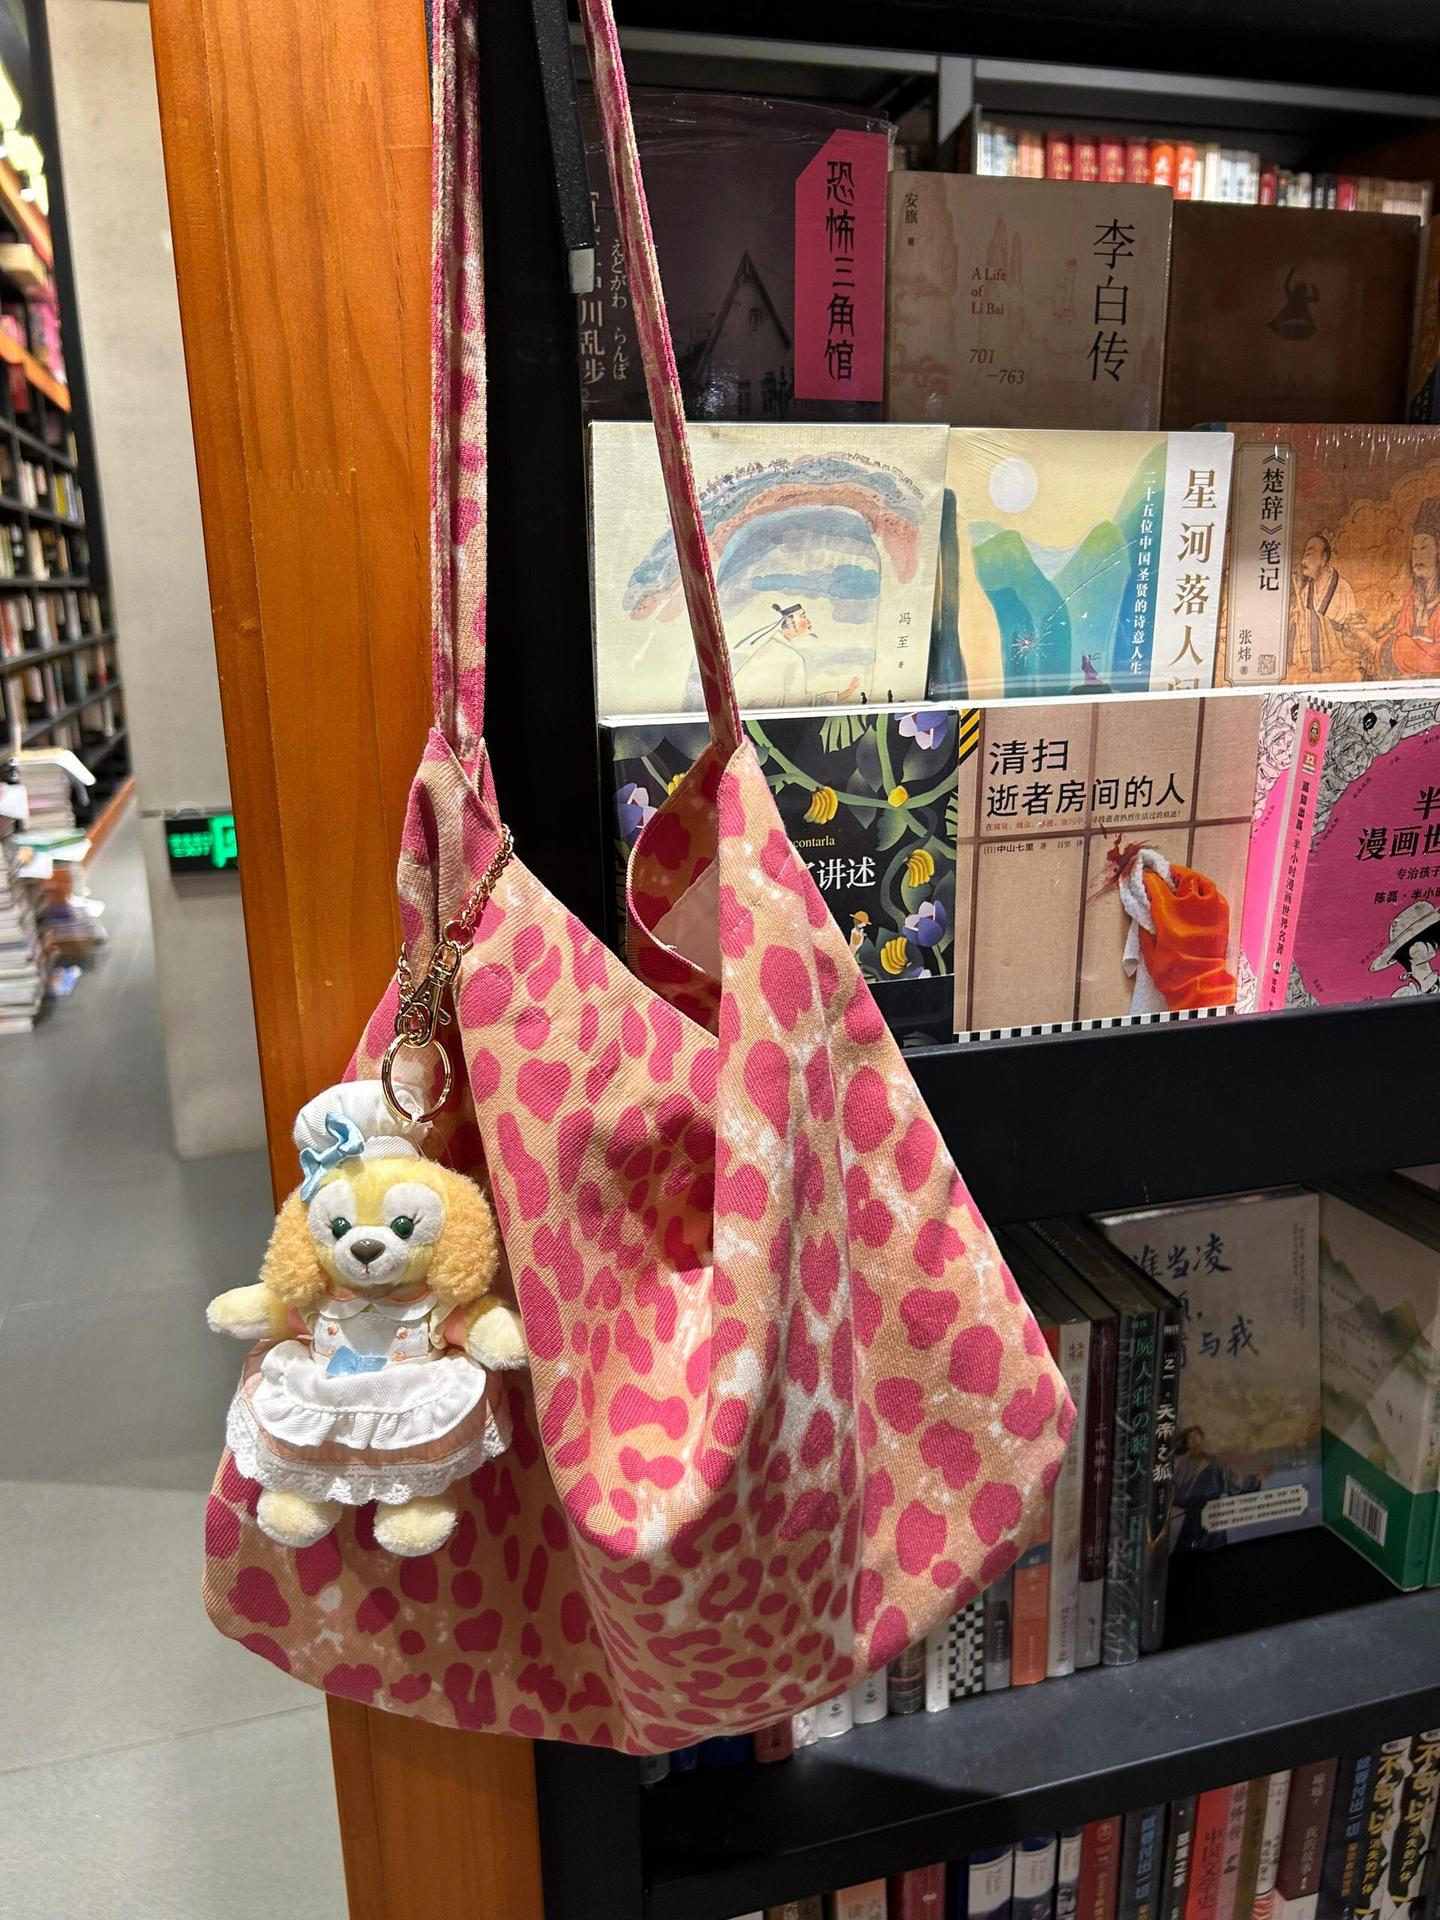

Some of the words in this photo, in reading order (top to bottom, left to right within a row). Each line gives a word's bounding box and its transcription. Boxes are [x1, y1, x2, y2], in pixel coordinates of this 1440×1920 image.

[609, 238, 628, 309] えどがわ
[824, 160, 856, 382] 恐怖三角馆
[971, 267, 982, 281] A
[985, 267, 1006, 282] Life
[971, 284, 984, 297] of
[971, 302, 983, 315] Li
[986, 302, 1005, 315] Bai
[1086, 218, 1136, 382] 李白传
[968, 349, 995, 364] 701
[1257, 454, 1286, 592] 《楚辞》笔记
[896, 611, 912, 649] 冯至
[1237, 628, 1252, 662] 张炜
[988, 738, 1070, 777] 清扫
[985, 772, 1187, 818] 逝者房间的人
[793, 836, 836, 850] contarla
[806, 856, 877, 892] 讲述
[1152, 1402, 1177, 1483] 天帝之狐
